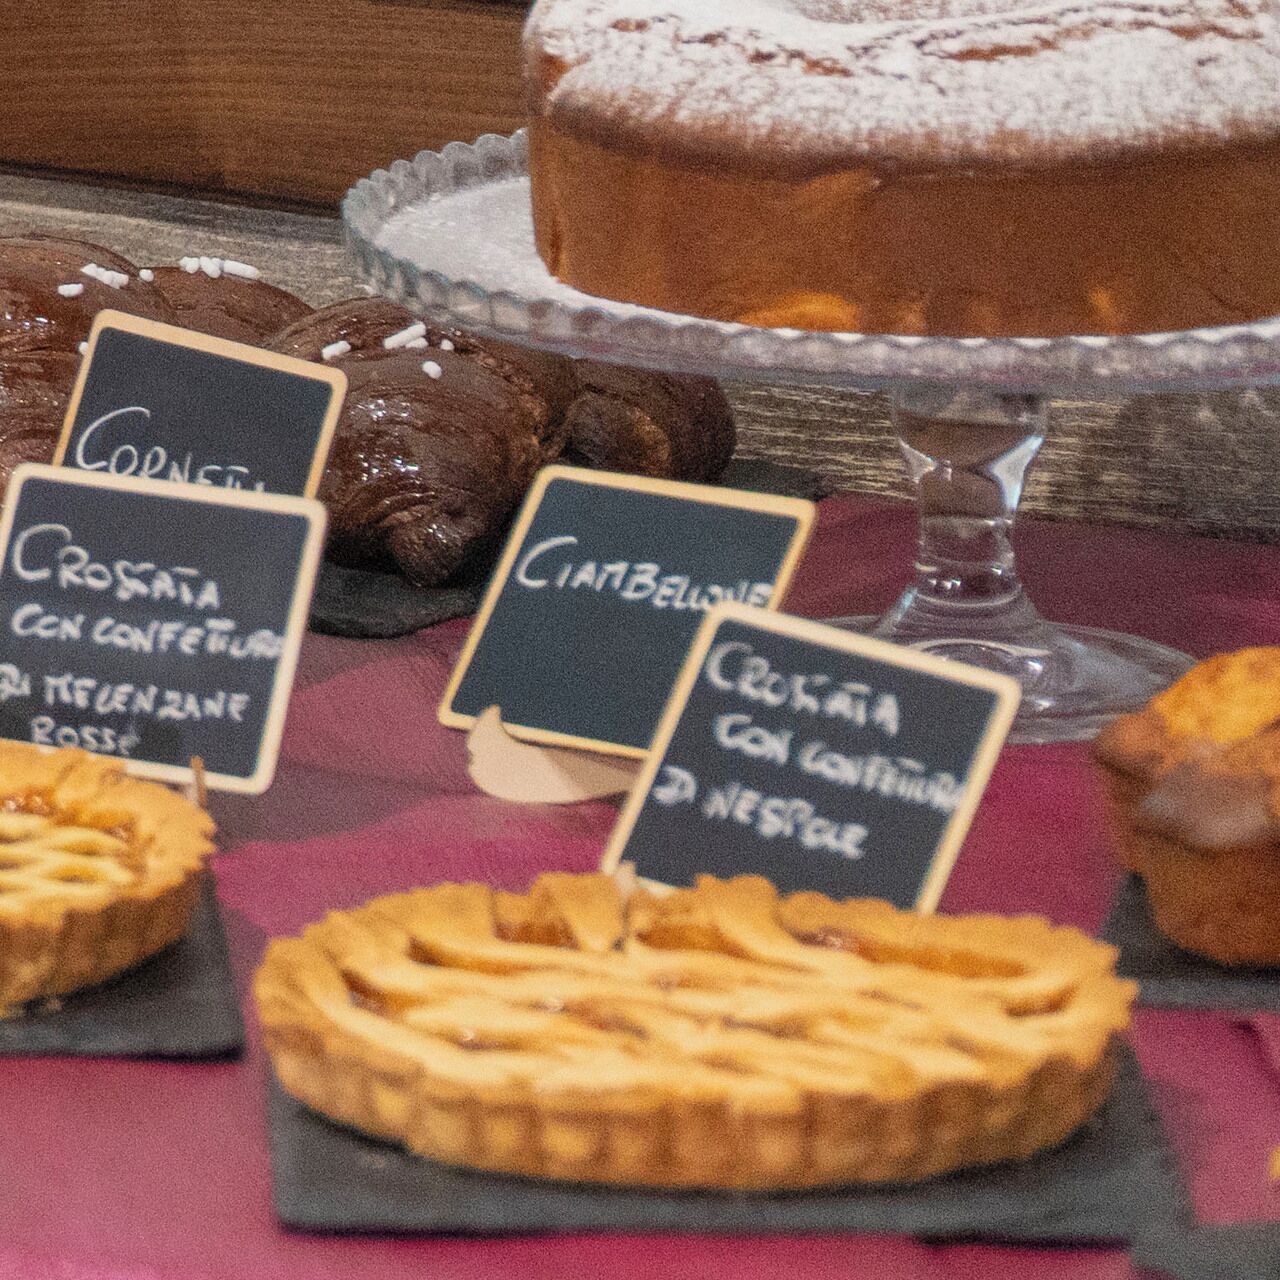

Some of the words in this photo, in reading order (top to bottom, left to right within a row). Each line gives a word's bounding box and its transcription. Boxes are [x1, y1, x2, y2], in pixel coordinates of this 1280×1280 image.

[11, 603, 85, 641] CON
[43, 673, 250, 721] MELENZANE
[715, 714, 792, 765] CON
[704, 782, 869, 858] NESPOLE
